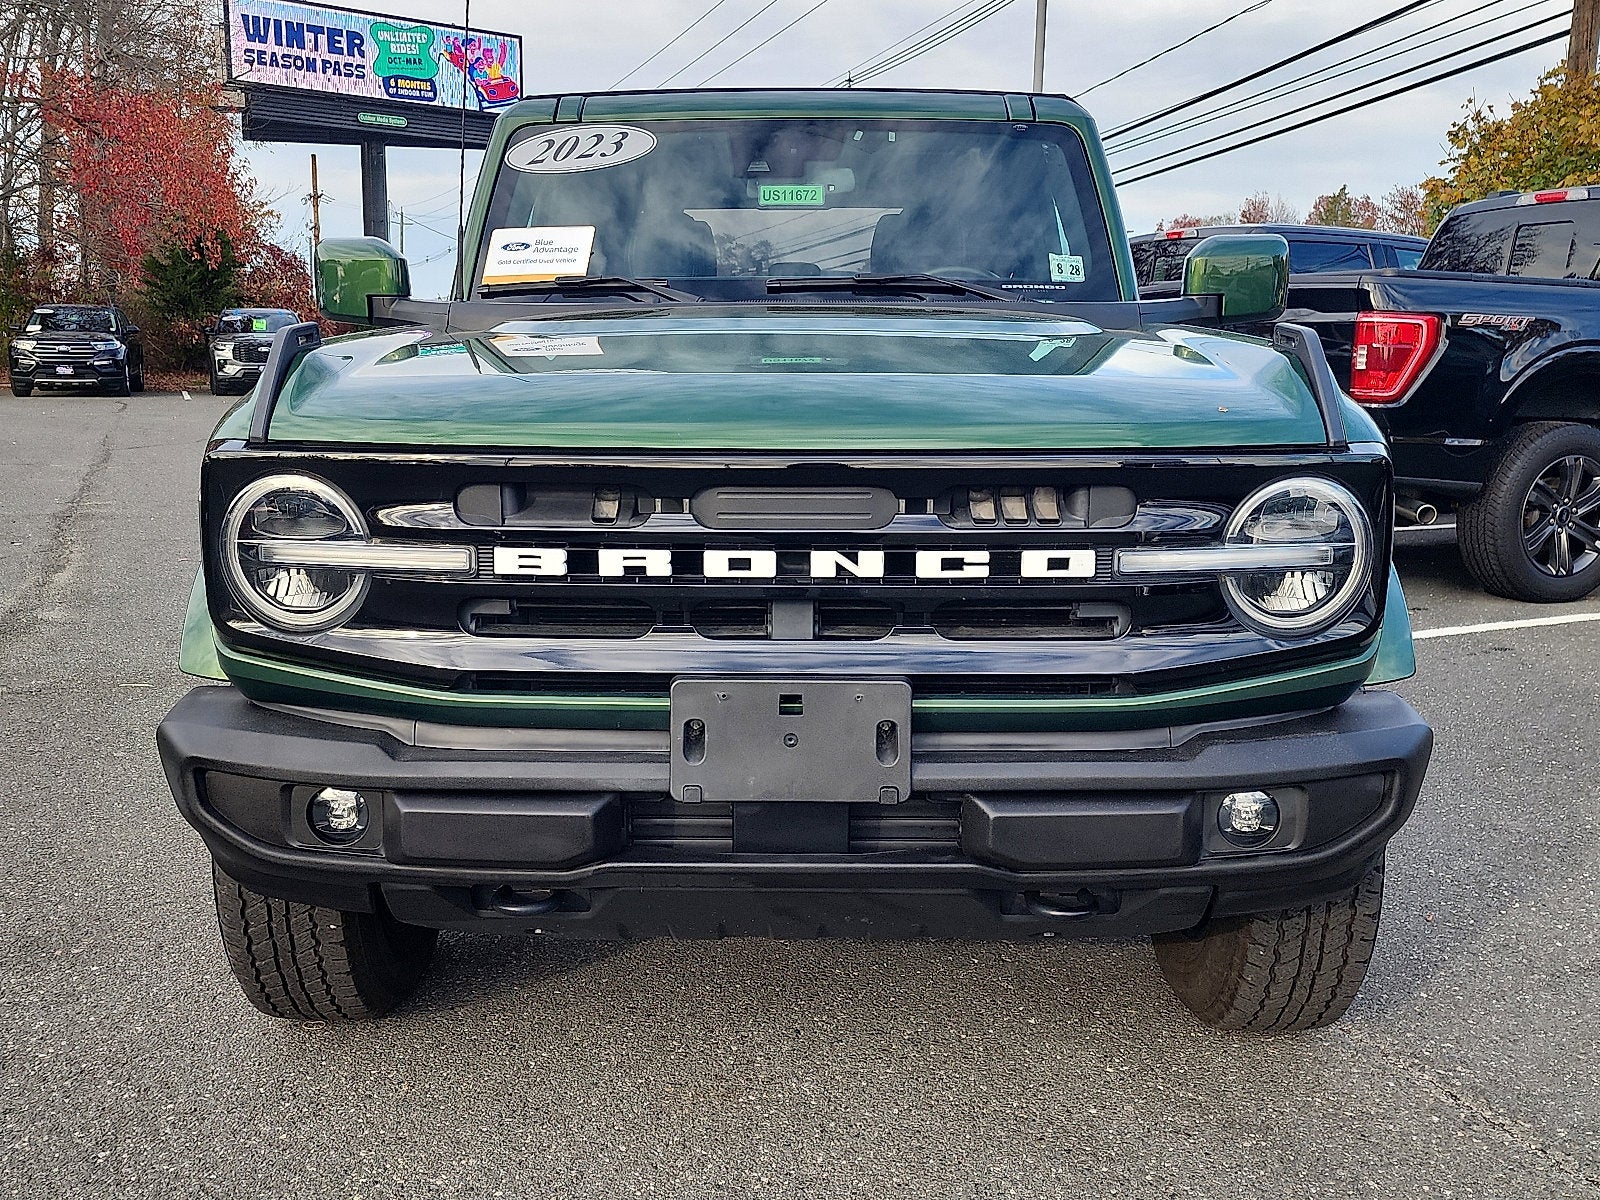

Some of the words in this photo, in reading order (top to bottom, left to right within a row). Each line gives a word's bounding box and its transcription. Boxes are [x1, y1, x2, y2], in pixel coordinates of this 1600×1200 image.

[240, 13, 365, 58] WINTER
[377, 30, 428, 44] UNLIMITED
[390, 42, 420, 55] RIDES!
[243, 47, 317, 73] SEASON
[320, 58, 366, 79] PASS
[388, 56, 423, 66] OCT-MAR
[390, 78, 396, 87] 6
[397, 78, 432, 91] MONTHS
[526, 131, 629, 166] 2023
[762, 189, 818, 202] US11672
[533, 246, 579, 254] Advantage
[1056, 262, 1064, 274] 8
[1069, 263, 1081, 276] 28
[1458, 313, 1536, 328] SPORT
[493, 546, 1096, 578] BRONCO
